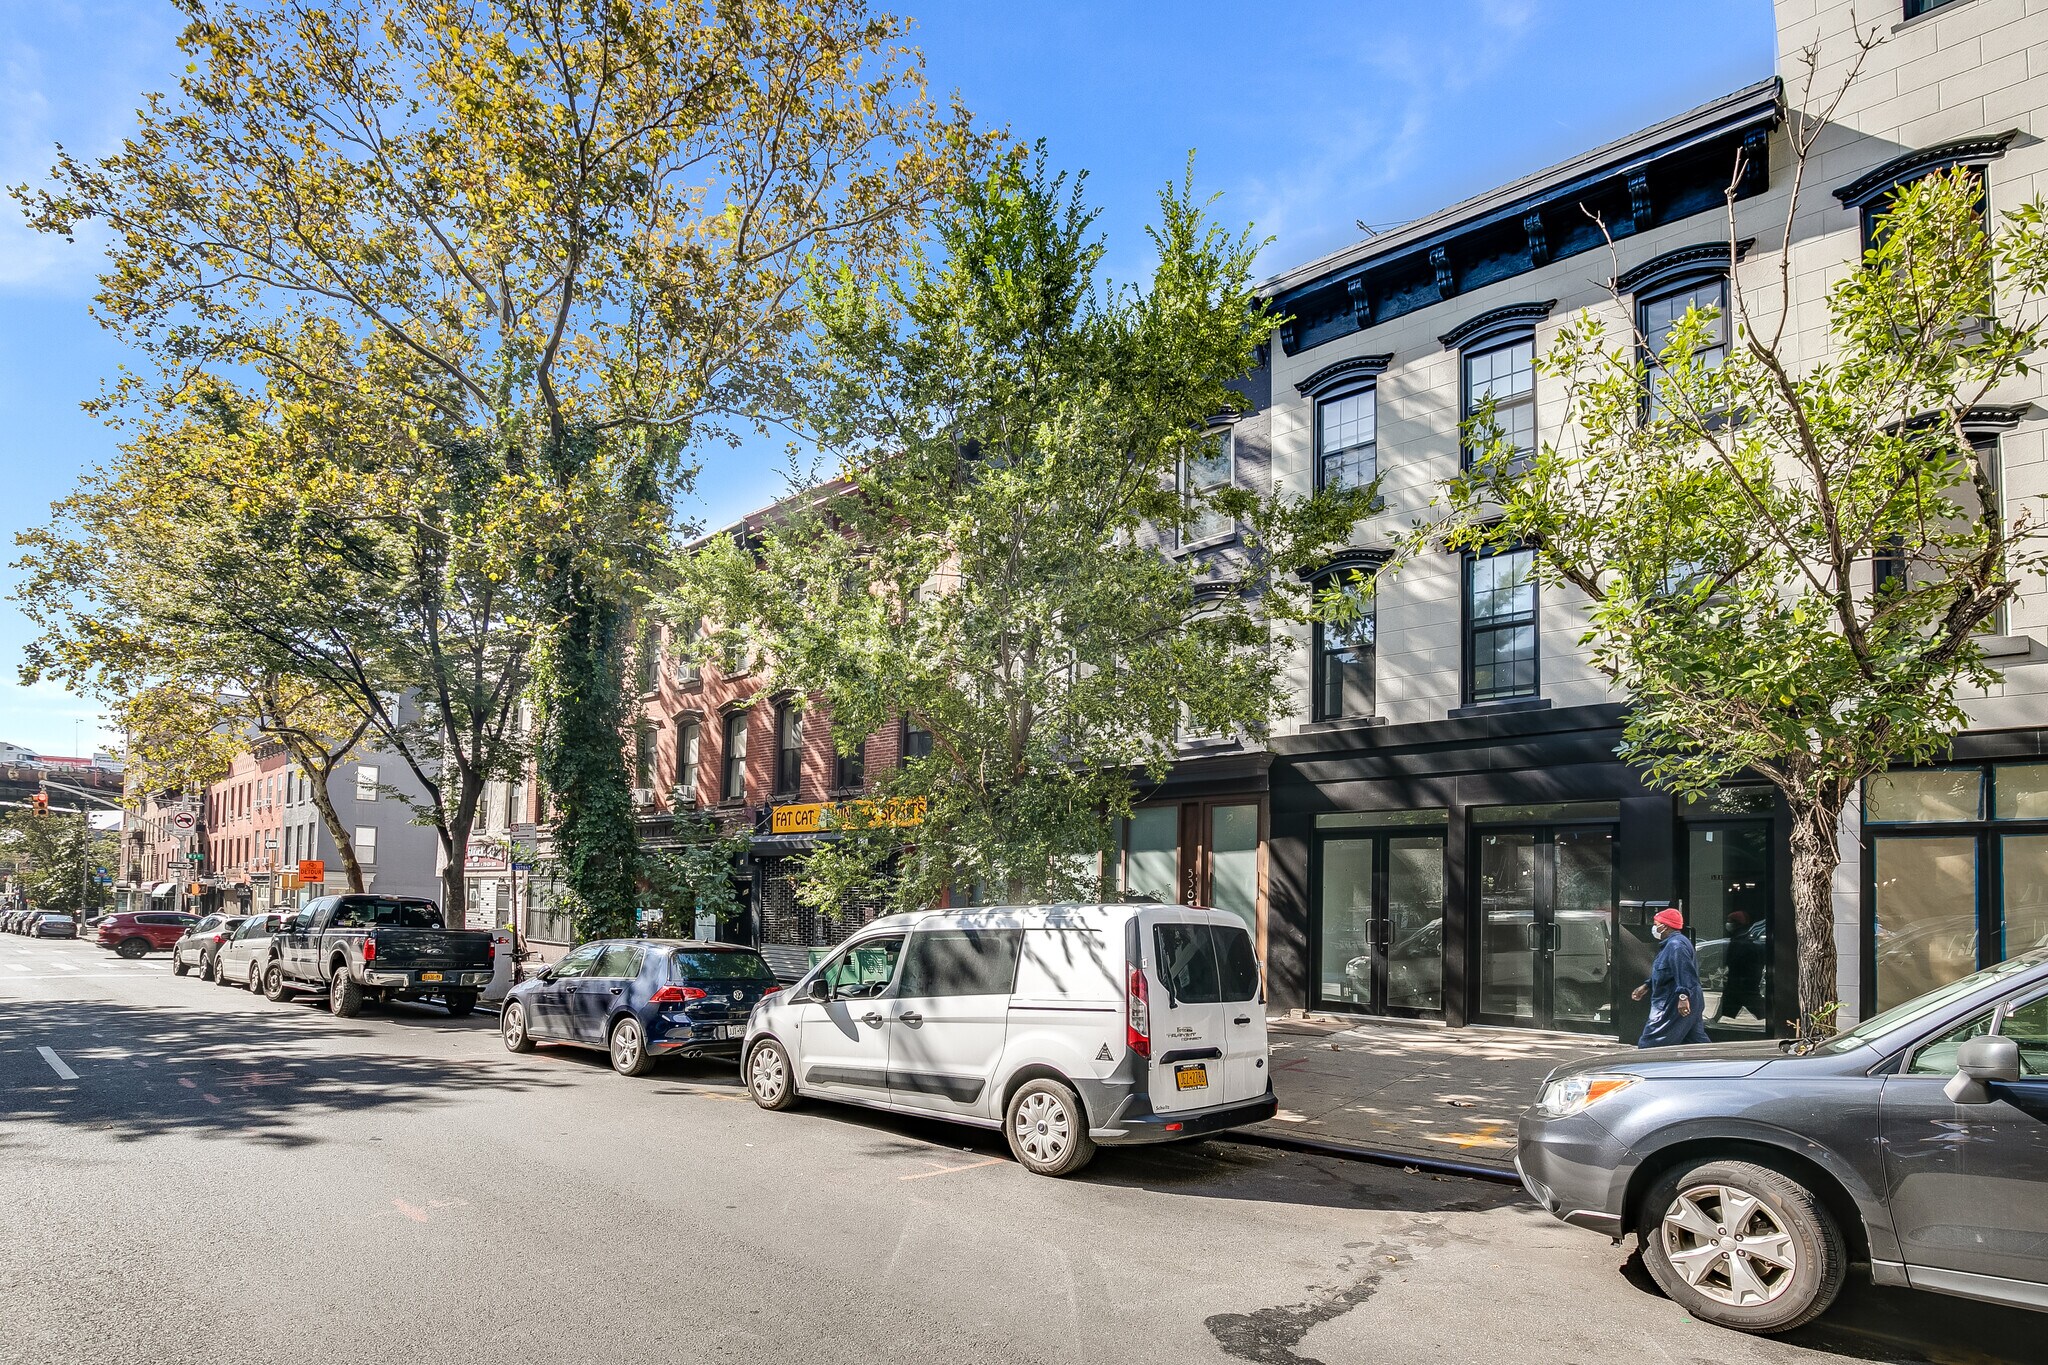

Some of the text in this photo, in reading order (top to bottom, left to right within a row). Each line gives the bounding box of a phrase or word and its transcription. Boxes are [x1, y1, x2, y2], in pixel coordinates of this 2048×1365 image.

[775, 811, 791, 827] FAT
[795, 809, 815, 826] CAT
[881, 802, 925, 820] SPRITS
